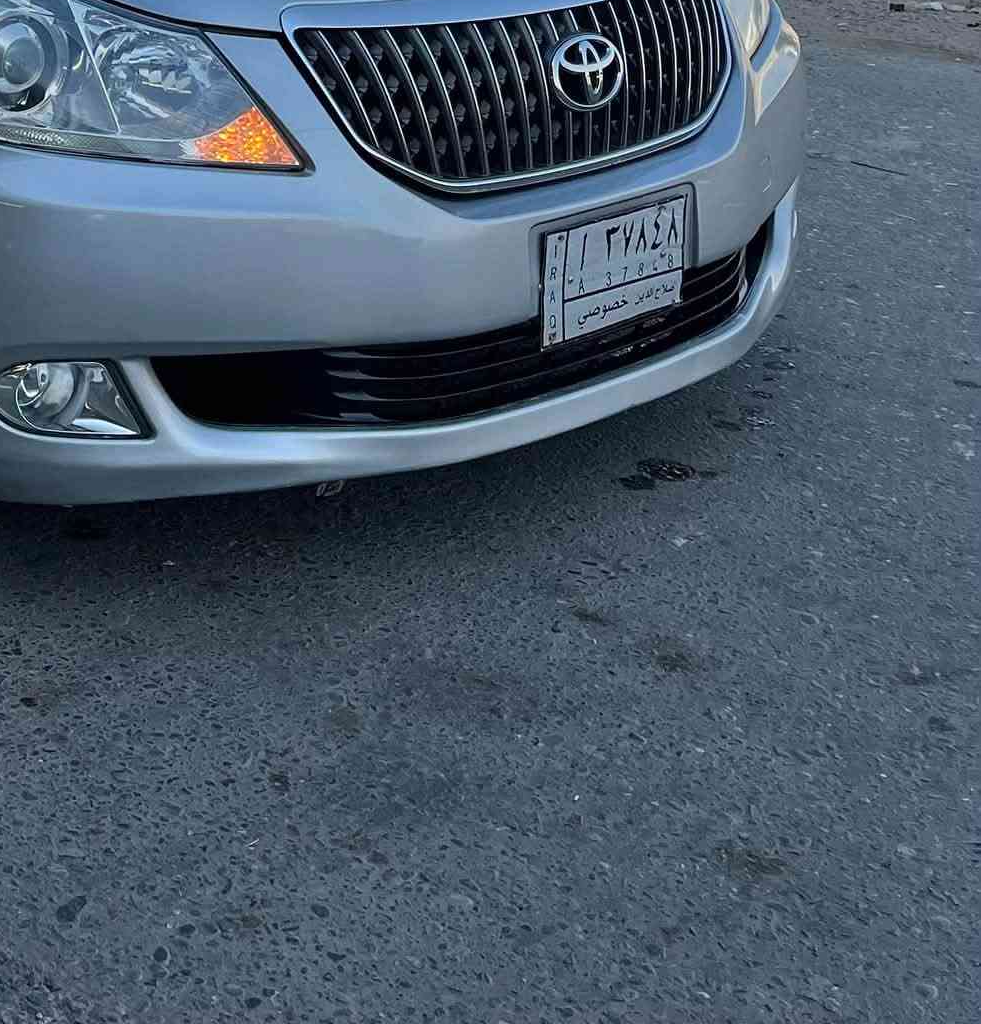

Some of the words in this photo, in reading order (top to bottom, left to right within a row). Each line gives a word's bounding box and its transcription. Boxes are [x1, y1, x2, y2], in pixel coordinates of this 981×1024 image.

[606, 206, 678, 262] ٣٧٨٤٨
[548, 244, 557, 329] IRAQ
[578, 294, 628, 329] خصوصي
